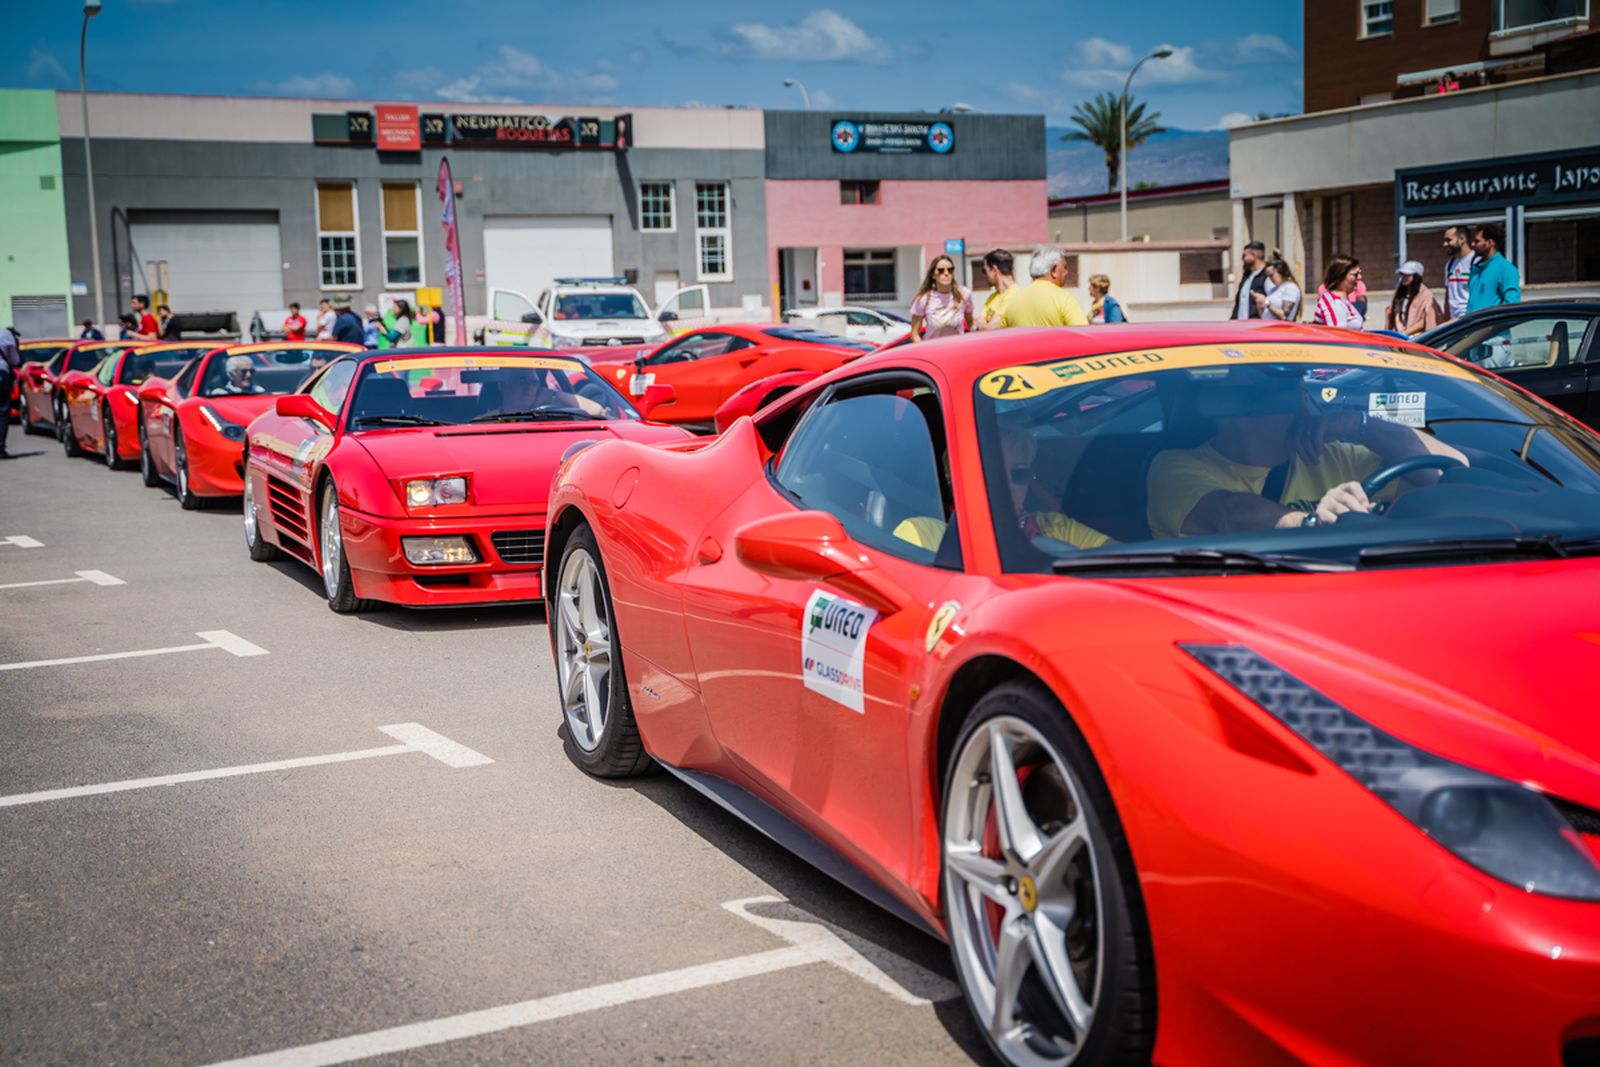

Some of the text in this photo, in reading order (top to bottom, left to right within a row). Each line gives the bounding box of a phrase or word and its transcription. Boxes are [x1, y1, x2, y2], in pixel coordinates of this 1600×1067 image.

[496, 127, 571, 142] ROQUETAS
[1405, 171, 1537, 201] Restaurante
[1085, 352, 1165, 371] UNED
[1388, 394, 1420, 404] UNED
[824, 603, 865, 638] UNED
[816, 661, 862, 693] GLASSDRIVE
